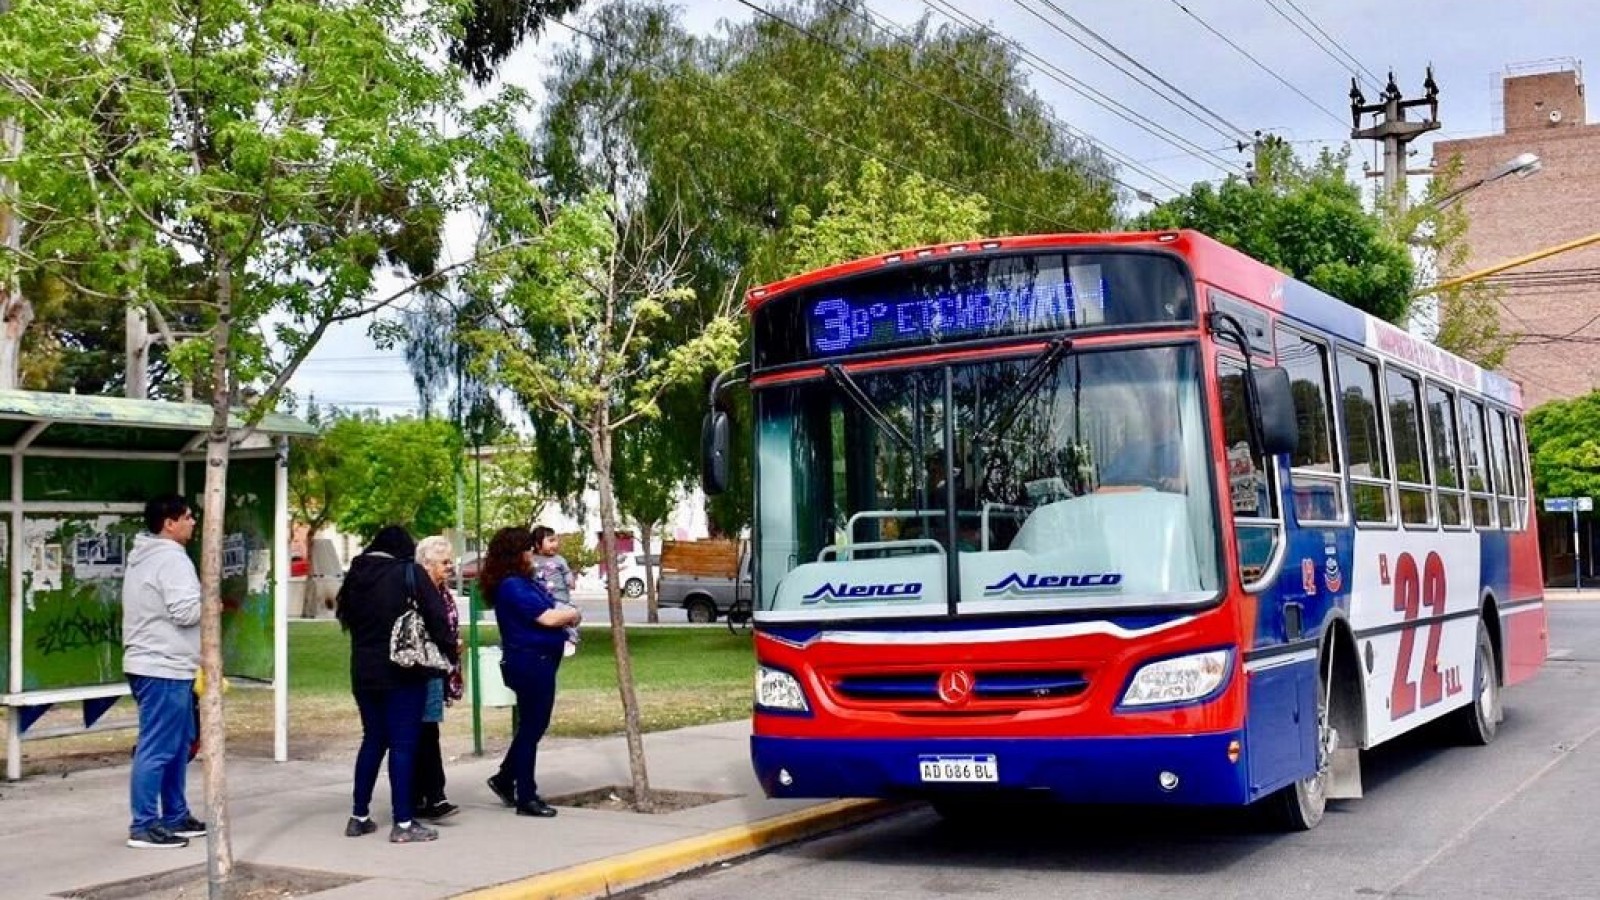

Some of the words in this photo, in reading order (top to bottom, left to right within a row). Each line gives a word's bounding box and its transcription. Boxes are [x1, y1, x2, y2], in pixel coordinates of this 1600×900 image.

[814, 298, 850, 350] 3
[802, 582, 923, 602] Alenco
[985, 572, 1122, 592] Alenco
[1391, 550, 1447, 722] 22
[924, 764, 941, 779] AD
[945, 764, 971, 779] 086
[975, 764, 993, 779] BL
